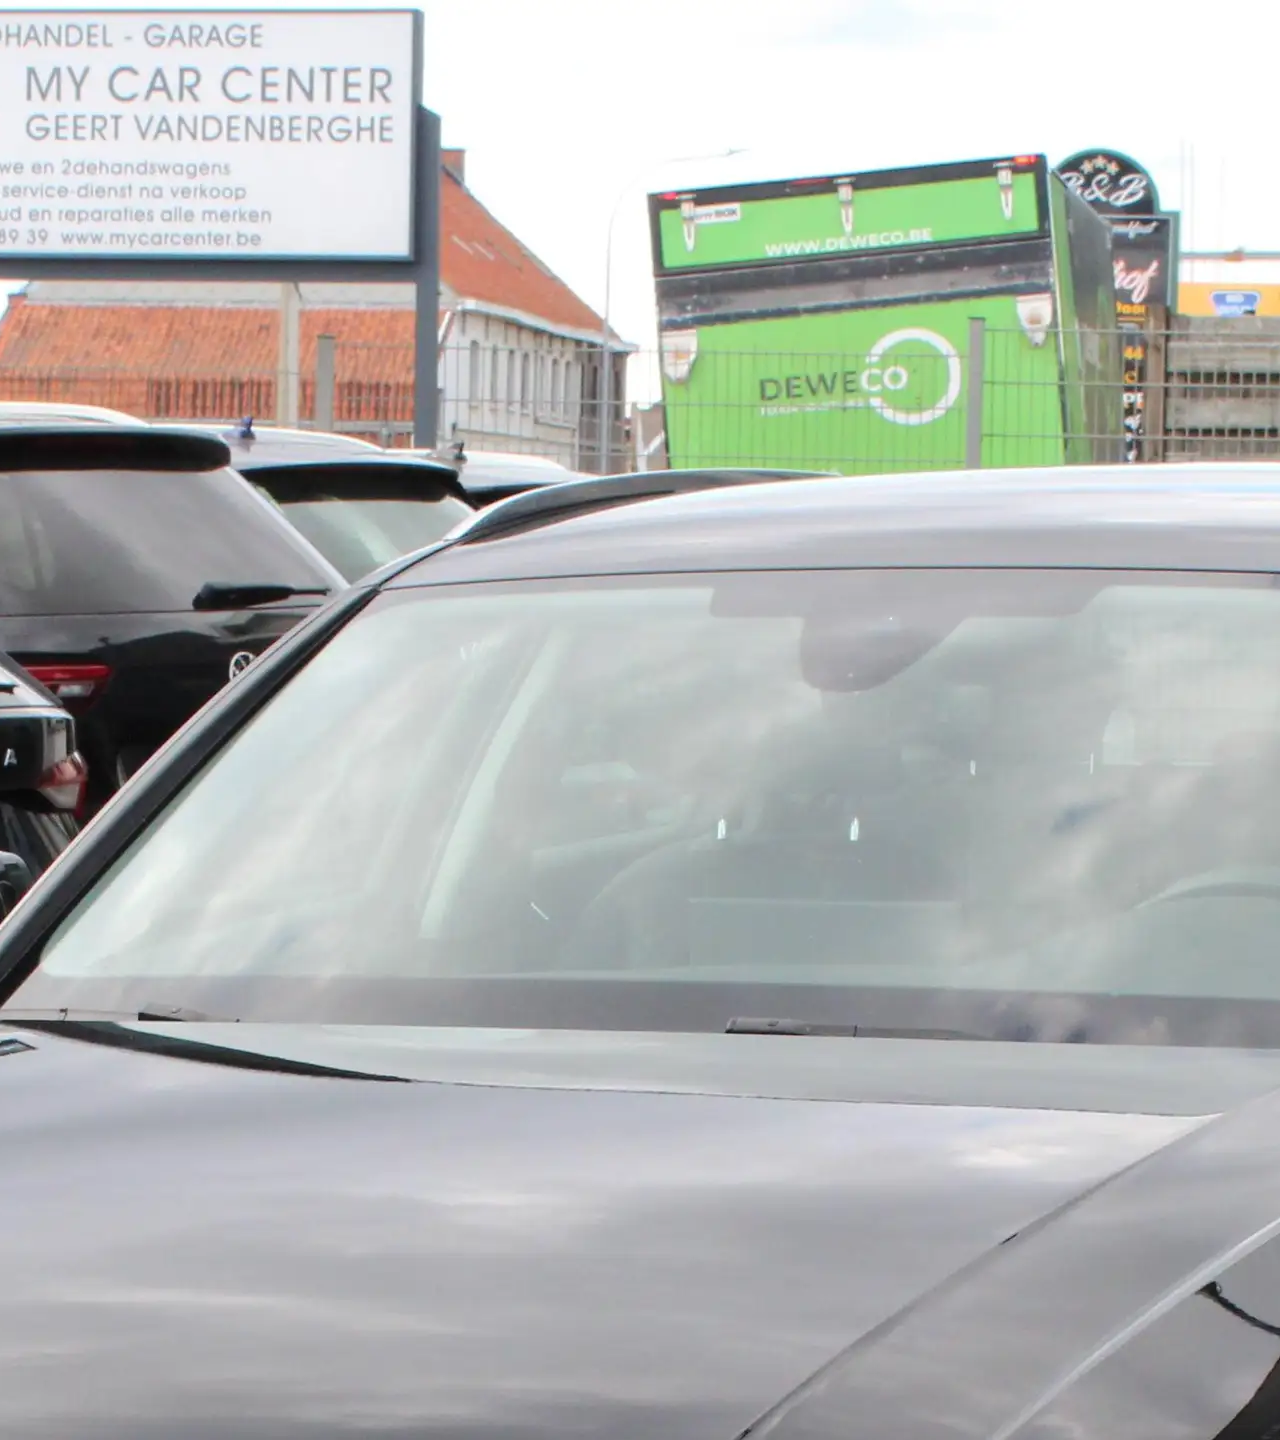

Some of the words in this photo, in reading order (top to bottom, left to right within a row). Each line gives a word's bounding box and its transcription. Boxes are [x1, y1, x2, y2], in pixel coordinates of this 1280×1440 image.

[143, 23, 263, 49] GARAGE
[26, 65, 91, 103] MY
[107, 65, 203, 104] CAR
[220, 66, 394, 105] CENTER
[24, 113, 122, 142] GEERT
[135, 114, 394, 143] VANDENBERGHE
[31, 161, 54, 175] en
[61, 158, 231, 180] 2dehandswagens
[2, 183, 133, 200] service-dienst
[139, 185, 164, 199] na
[170, 183, 247, 202] verkoop
[28, 208, 52, 222] en
[58, 206, 155, 225] reparaties
[160, 206, 195, 223] alle
[202, 207, 272, 224] merken
[27, 228, 49, 245] 39
[61, 230, 263, 249] www.mycarcenter.be
[765, 228, 934, 257] WWW.DEWECO.BE
[759, 366, 908, 402] DEWECO
